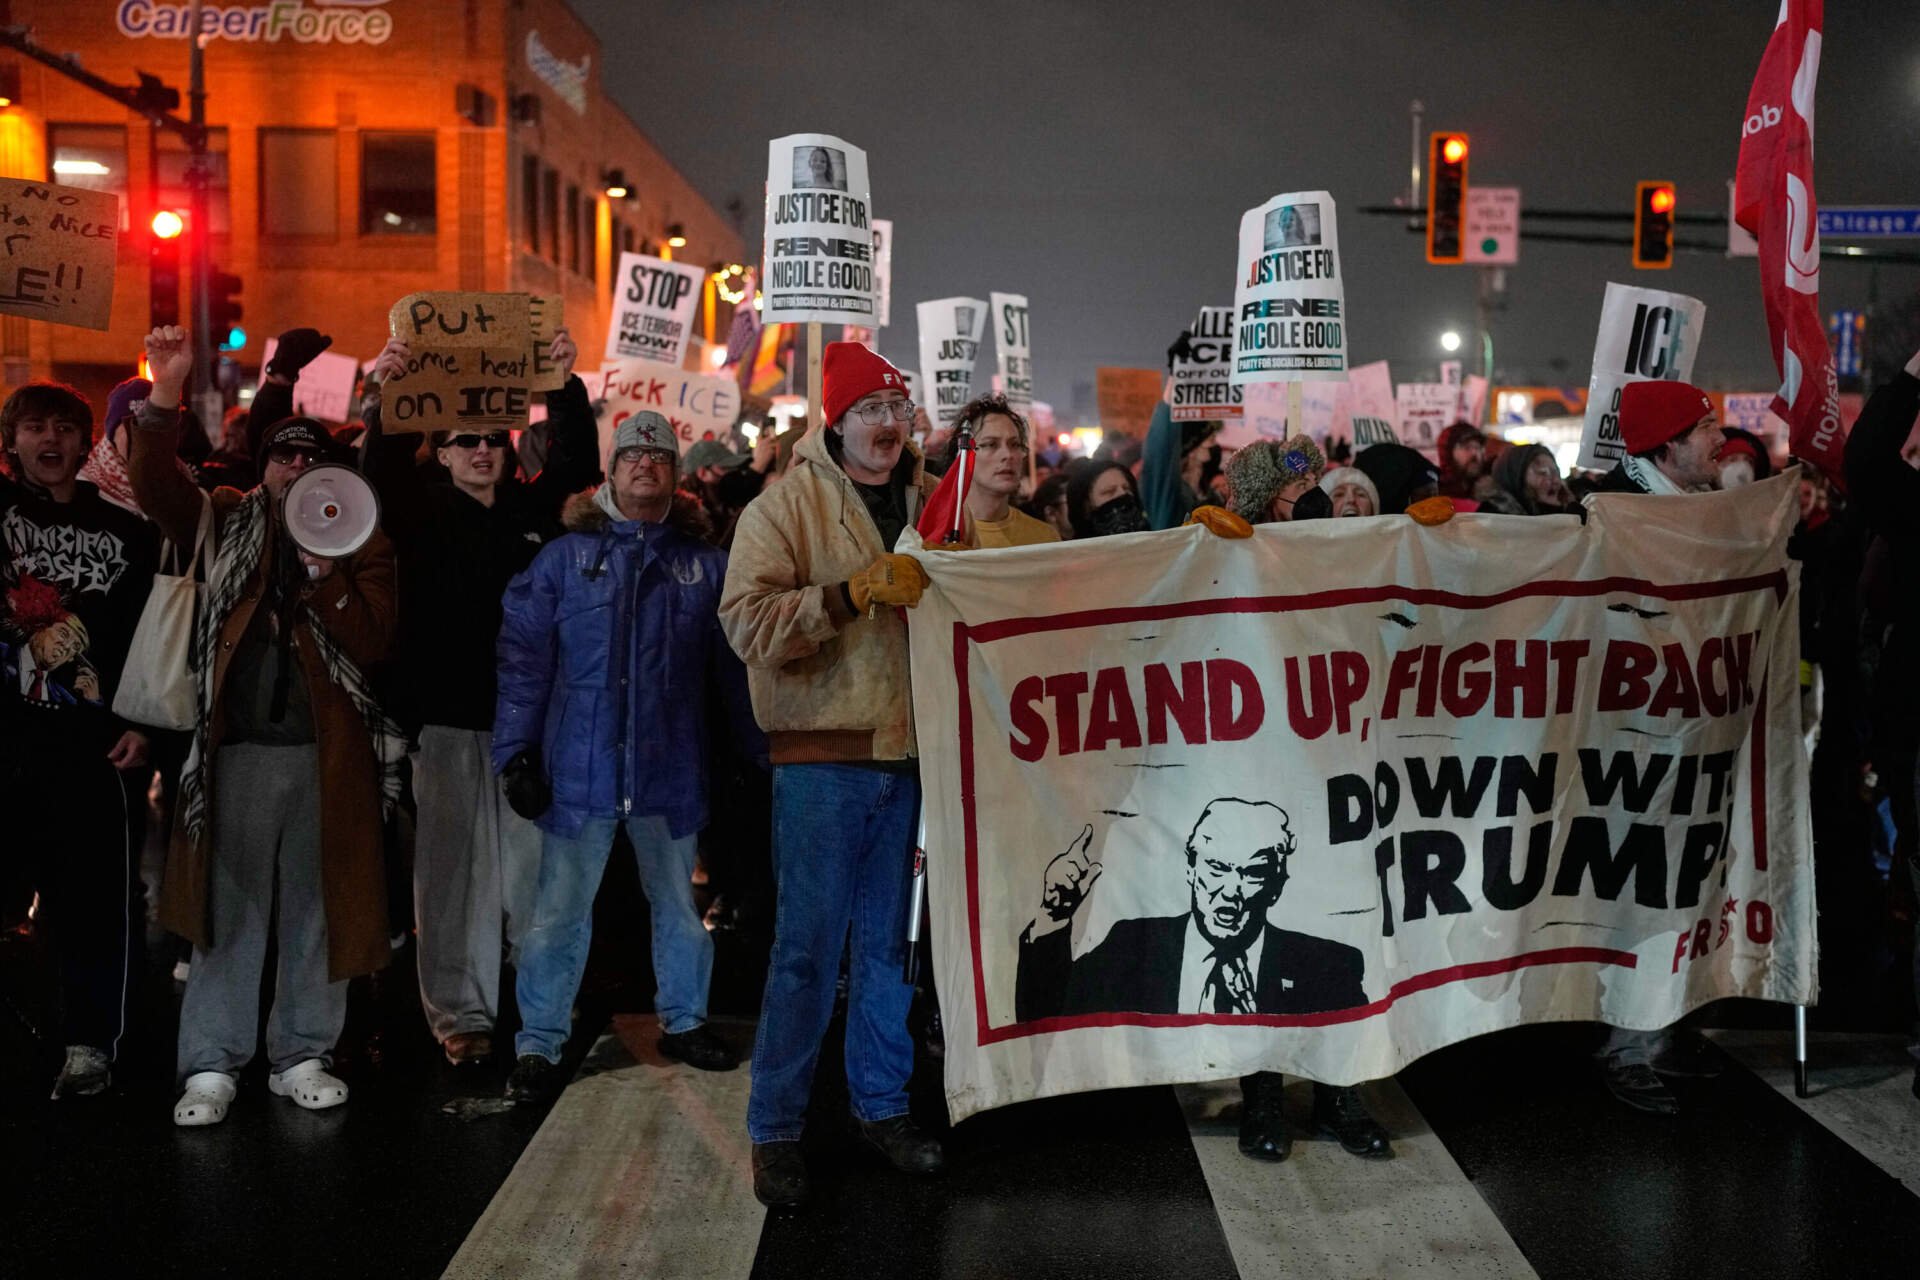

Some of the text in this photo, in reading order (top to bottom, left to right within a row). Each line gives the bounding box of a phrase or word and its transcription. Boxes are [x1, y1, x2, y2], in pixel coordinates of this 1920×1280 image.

[119, 0, 391, 43] CareerForce
[23, 186, 80, 206] NO
[775, 192, 868, 230] JUSTICE FOR
[1820, 213, 1906, 235] Chicago
[773, 236, 870, 262] RENEE
[772, 260, 871, 292] NICOLE GOOD
[1247, 250, 1312, 288] JUSTICE
[627, 265, 692, 310] STOP
[1193, 312, 1233, 338] ILLE
[1241, 298, 1341, 321] RENEE
[1239, 321, 1342, 352] NICOLE GOOD
[1624, 303, 1688, 380] ICE
[481, 350, 528, 378] heat
[1181, 343, 1232, 364] CE
[1306, 357, 1314, 368] &
[1176, 369, 1231, 379] OFF OU
[395, 386, 528, 420] on ICE
[679, 382, 731, 418] ICE
[1173, 383, 1243, 404] STREETS
[1009, 658, 1265, 762] STAND
[1284, 651, 1370, 742] UP,
[1381, 639, 1590, 719] FIGHT
[1327, 748, 1735, 845] DOWN WIT
